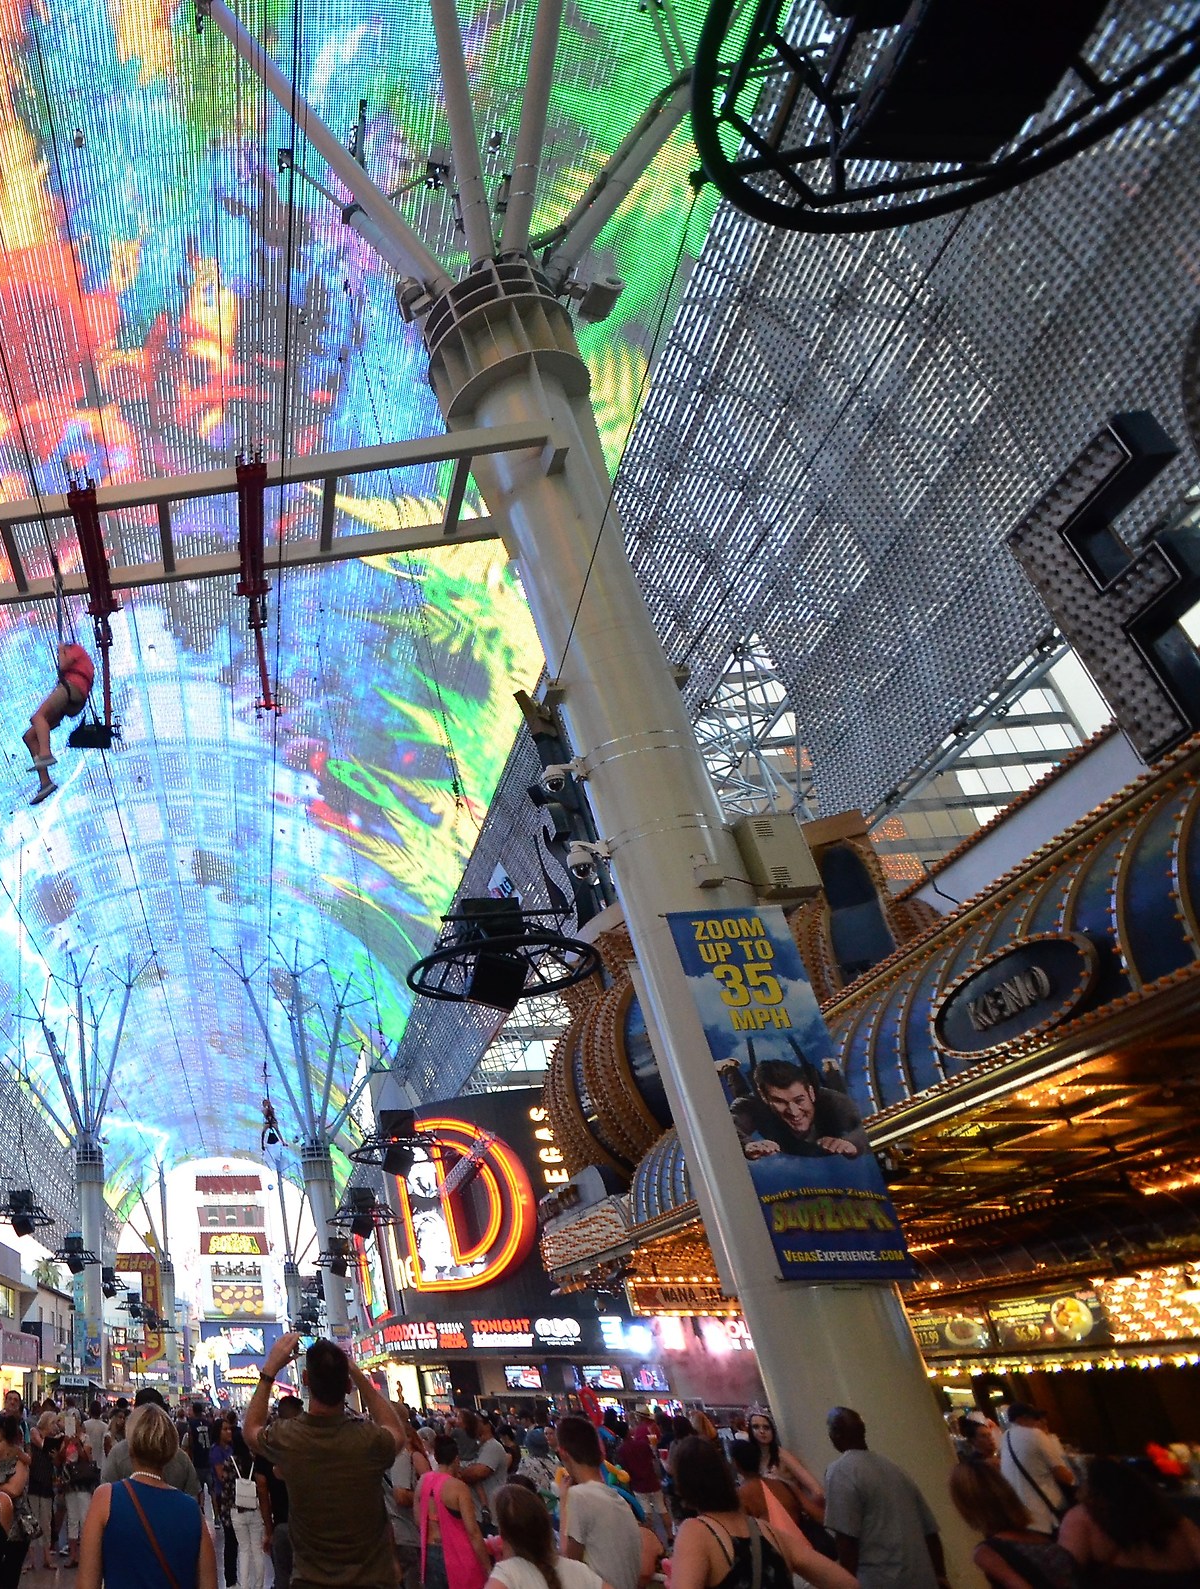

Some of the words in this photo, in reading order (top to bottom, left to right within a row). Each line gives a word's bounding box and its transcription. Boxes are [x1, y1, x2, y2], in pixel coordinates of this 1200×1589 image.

[691, 917, 766, 941] ZOOM
[698, 942, 732, 963] UP
[738, 939, 775, 961] TO
[712, 962, 784, 1007] 35
[728, 1007, 792, 1031] MPH
[529, 1106, 571, 1194] EGAS
[396, 1117, 538, 1293] D
[660, 1287, 698, 1303] WANA
[143, 1274, 160, 1349] BIS
[470, 1318, 531, 1334] TONIGHT
[417, 1338, 438, 1350] NOW
